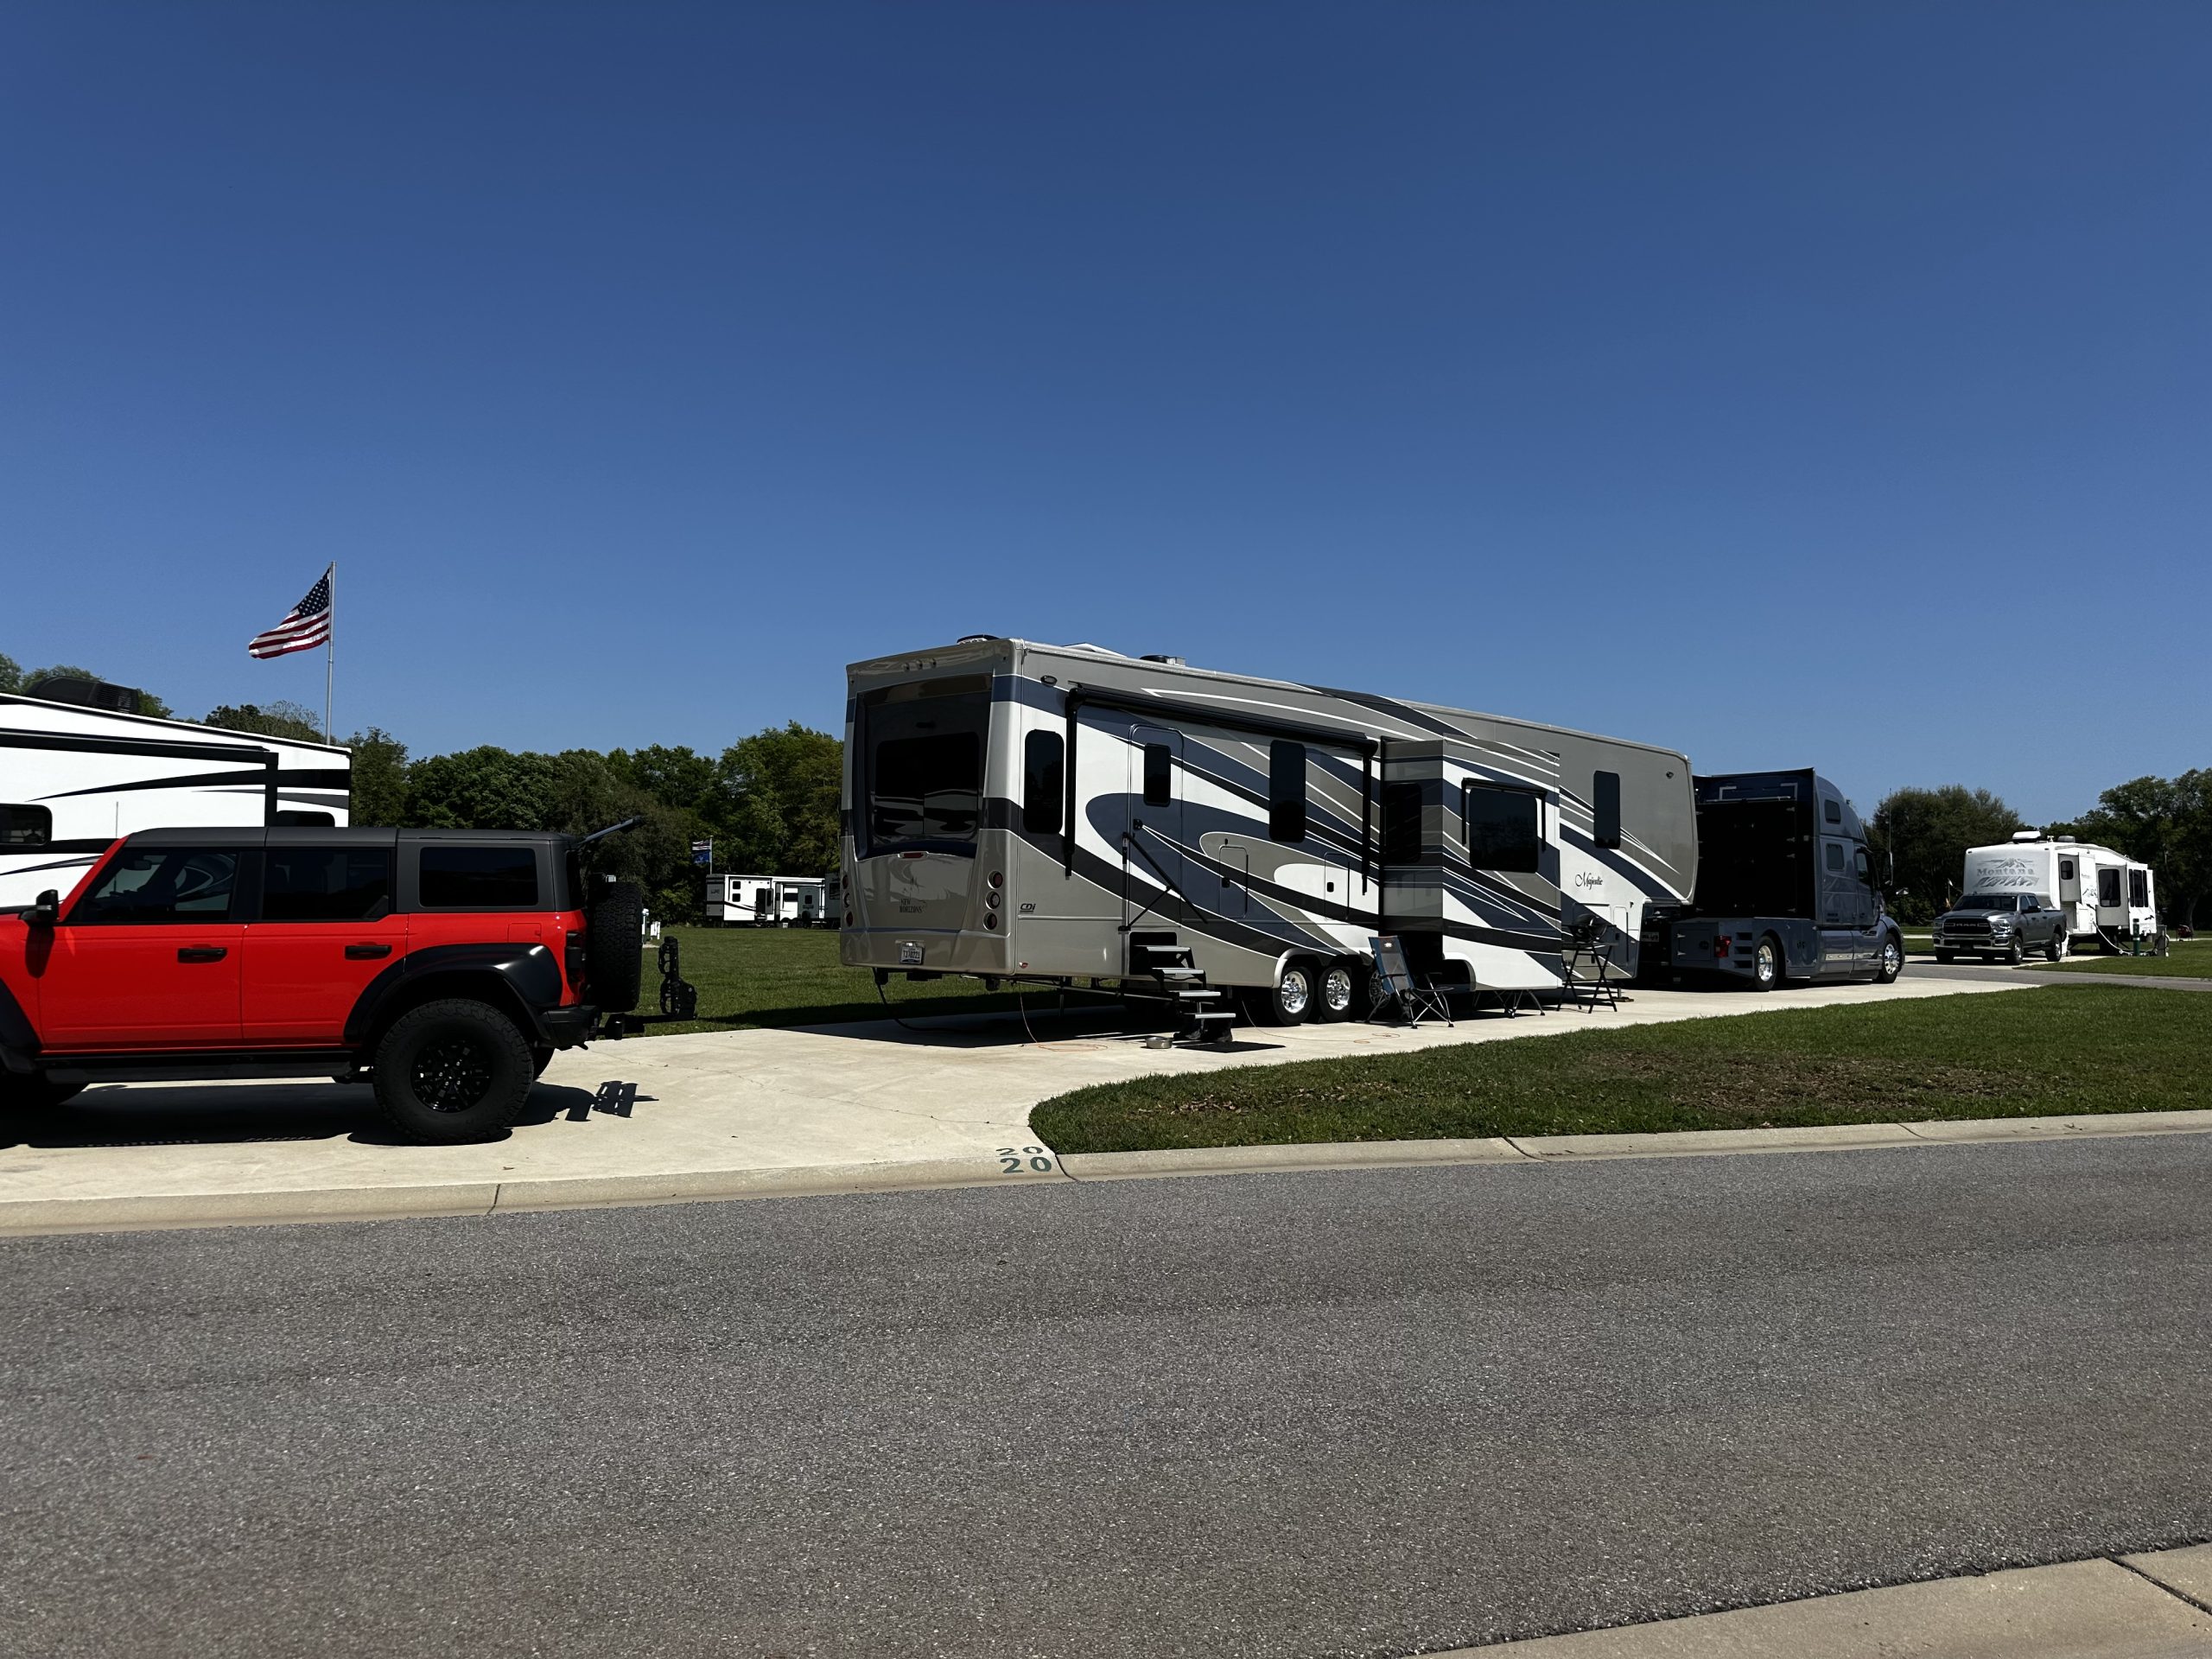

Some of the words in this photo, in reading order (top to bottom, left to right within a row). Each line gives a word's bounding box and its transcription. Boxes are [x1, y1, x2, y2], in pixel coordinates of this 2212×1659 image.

[1977, 868, 2034, 876] Montana
[1574, 872, 1604, 890] Majestic
[995, 1146, 1044, 1155] 20
[1000, 1156, 1052, 1173] 20
